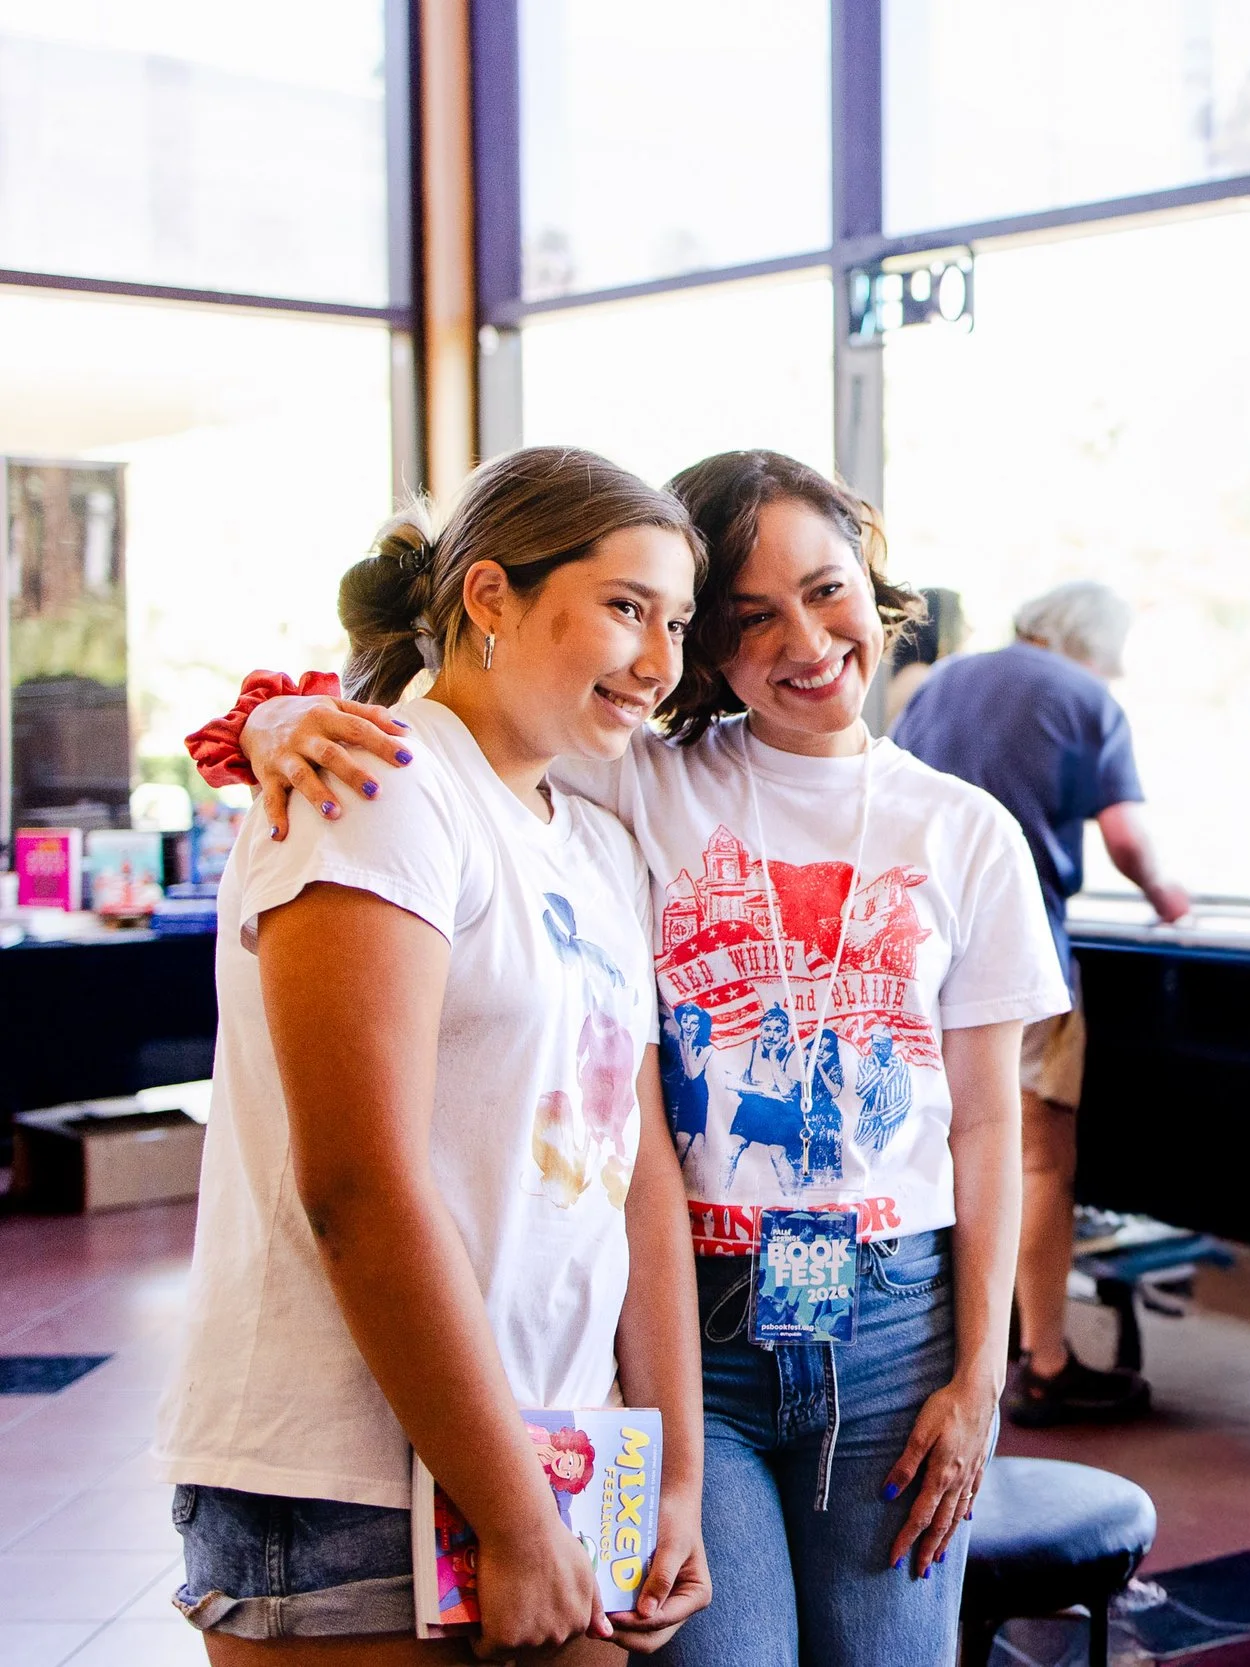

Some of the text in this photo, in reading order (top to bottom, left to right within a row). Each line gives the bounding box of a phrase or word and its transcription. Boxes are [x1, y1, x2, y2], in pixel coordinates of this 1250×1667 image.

[831, 976, 907, 1010] BLAINE
[767, 1238, 852, 1267] BOOK
[775, 1260, 845, 1288] FEST
[761, 1323, 815, 1332] psbookfest.org
[599, 1466, 615, 1562] FEELINGS
[610, 1425, 651, 1593] MIXED
